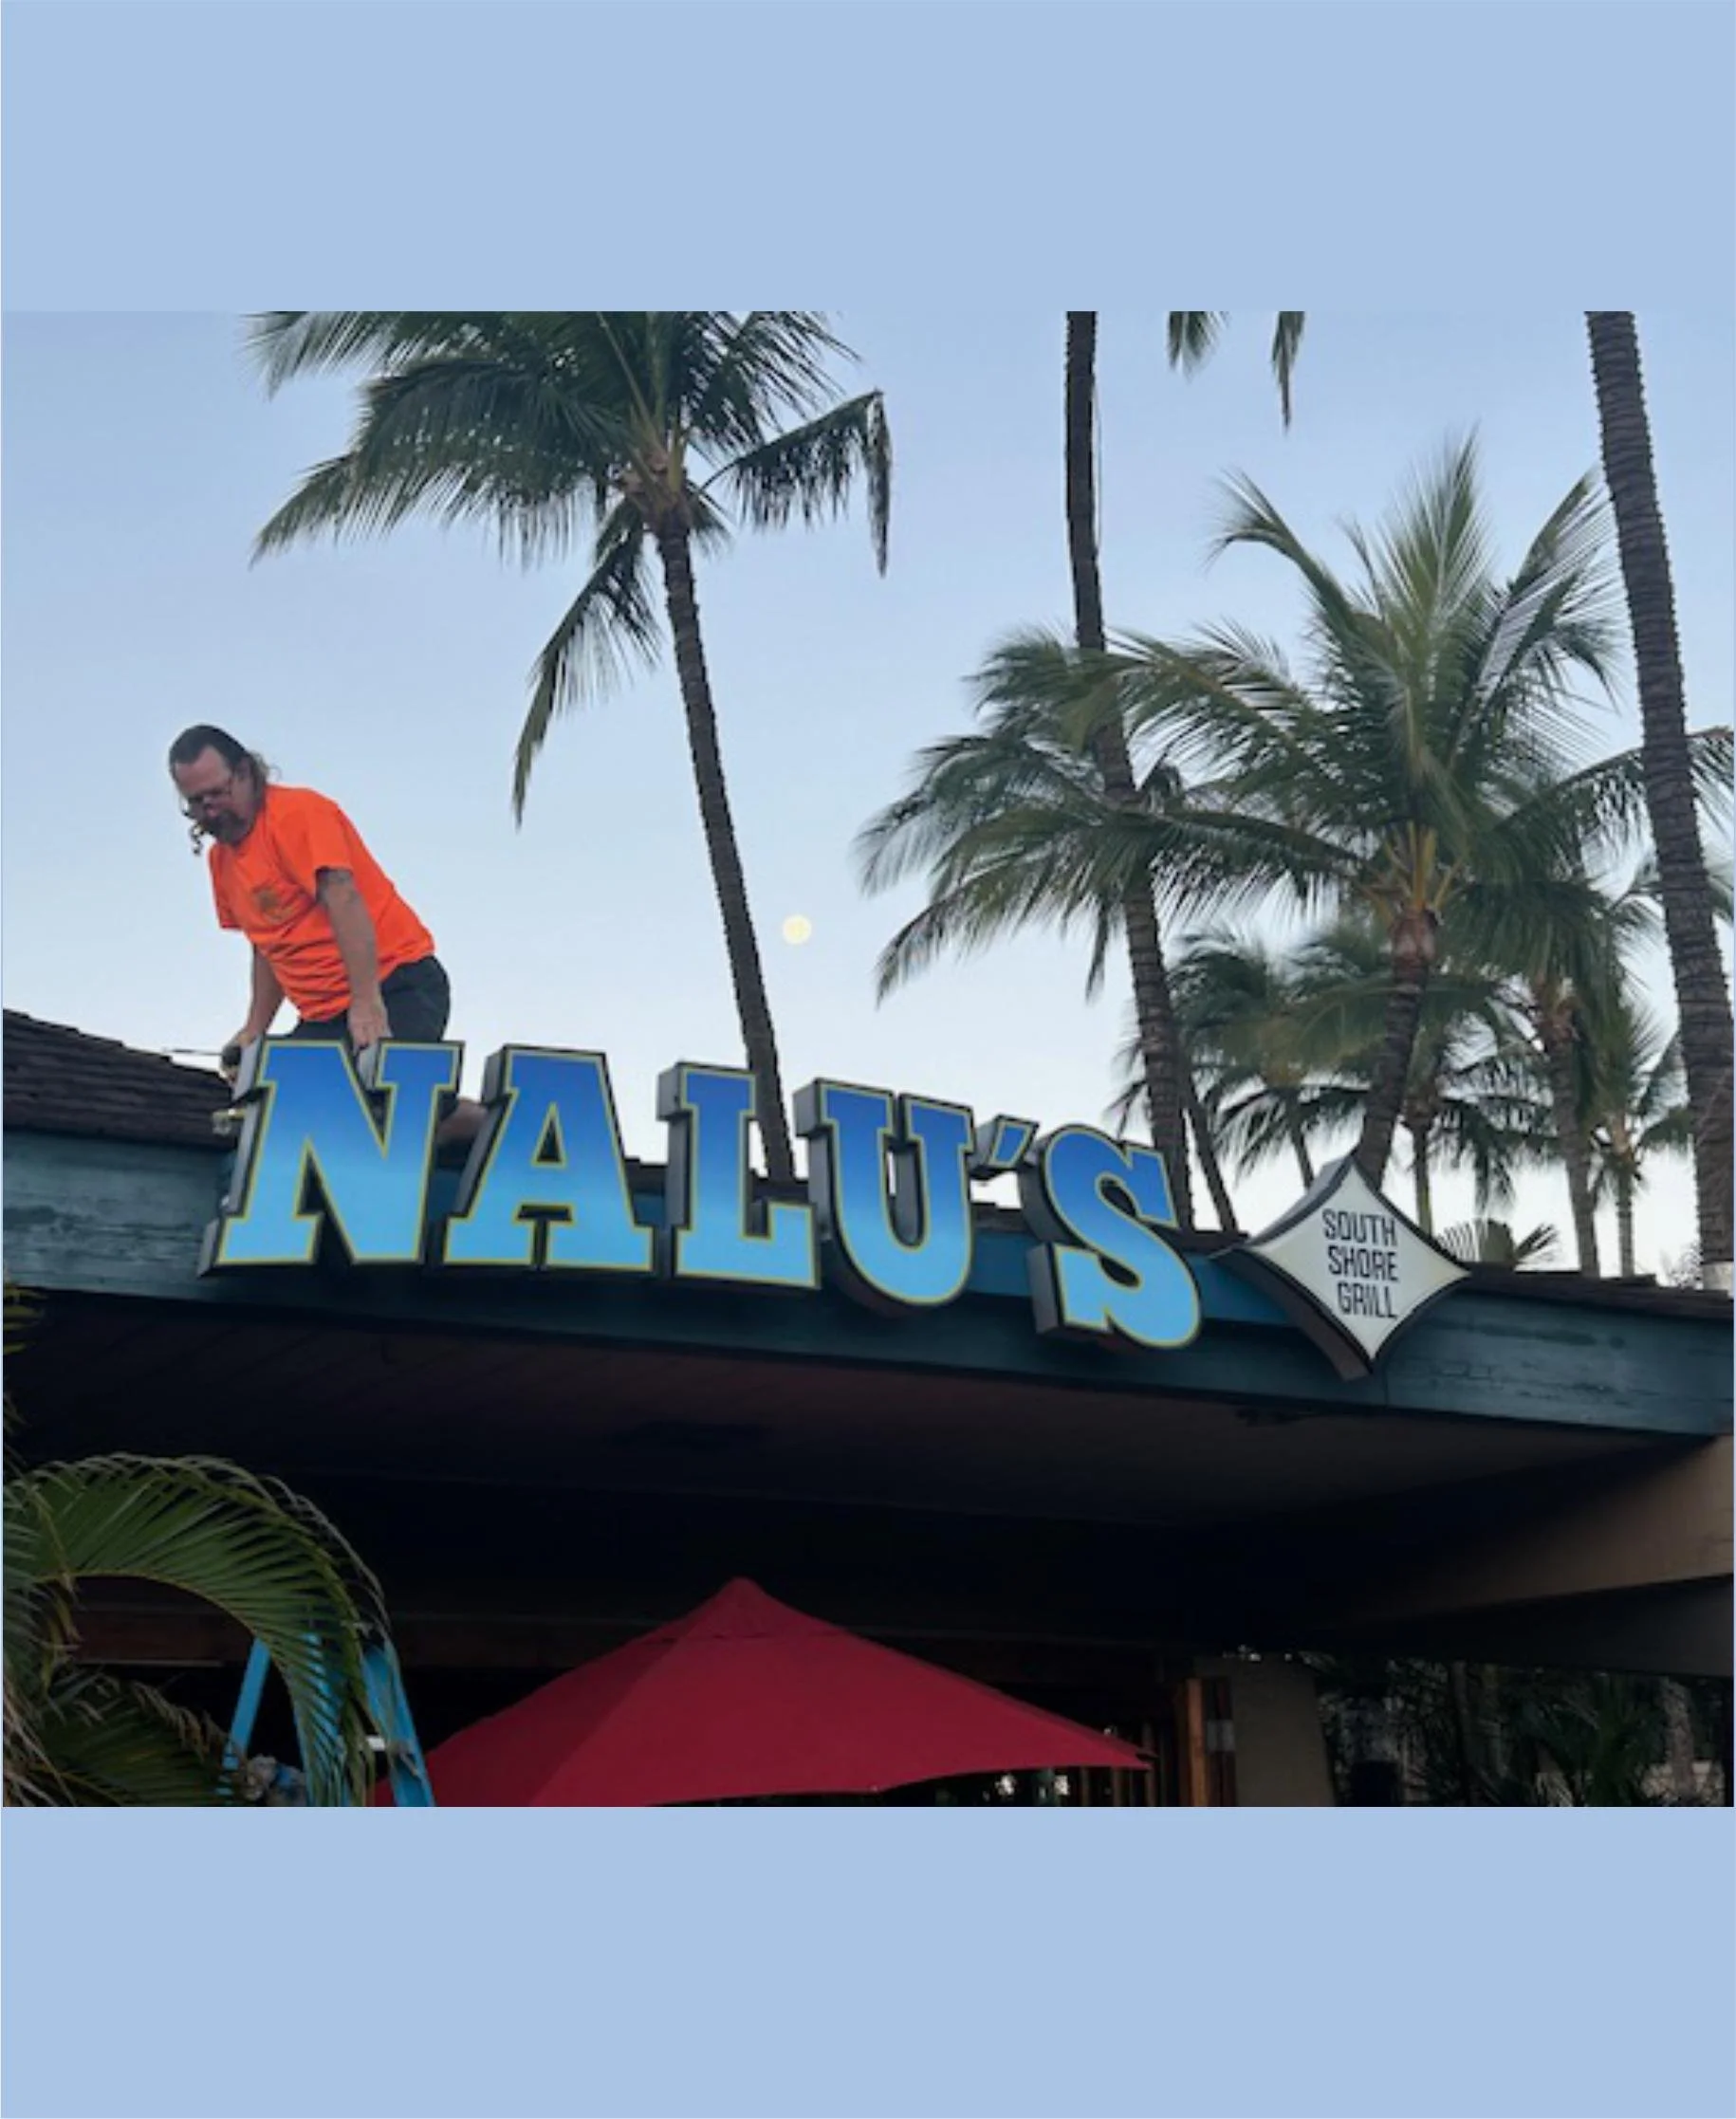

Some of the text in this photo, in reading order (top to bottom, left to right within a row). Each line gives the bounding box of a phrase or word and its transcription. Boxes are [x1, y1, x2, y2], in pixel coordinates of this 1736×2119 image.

[214, 1039, 1203, 1348] NALU'S
[1321, 1207, 1397, 1246] SOUTH
[1328, 1244, 1399, 1281] SHORE
[1337, 1281, 1398, 1319] GRILL
